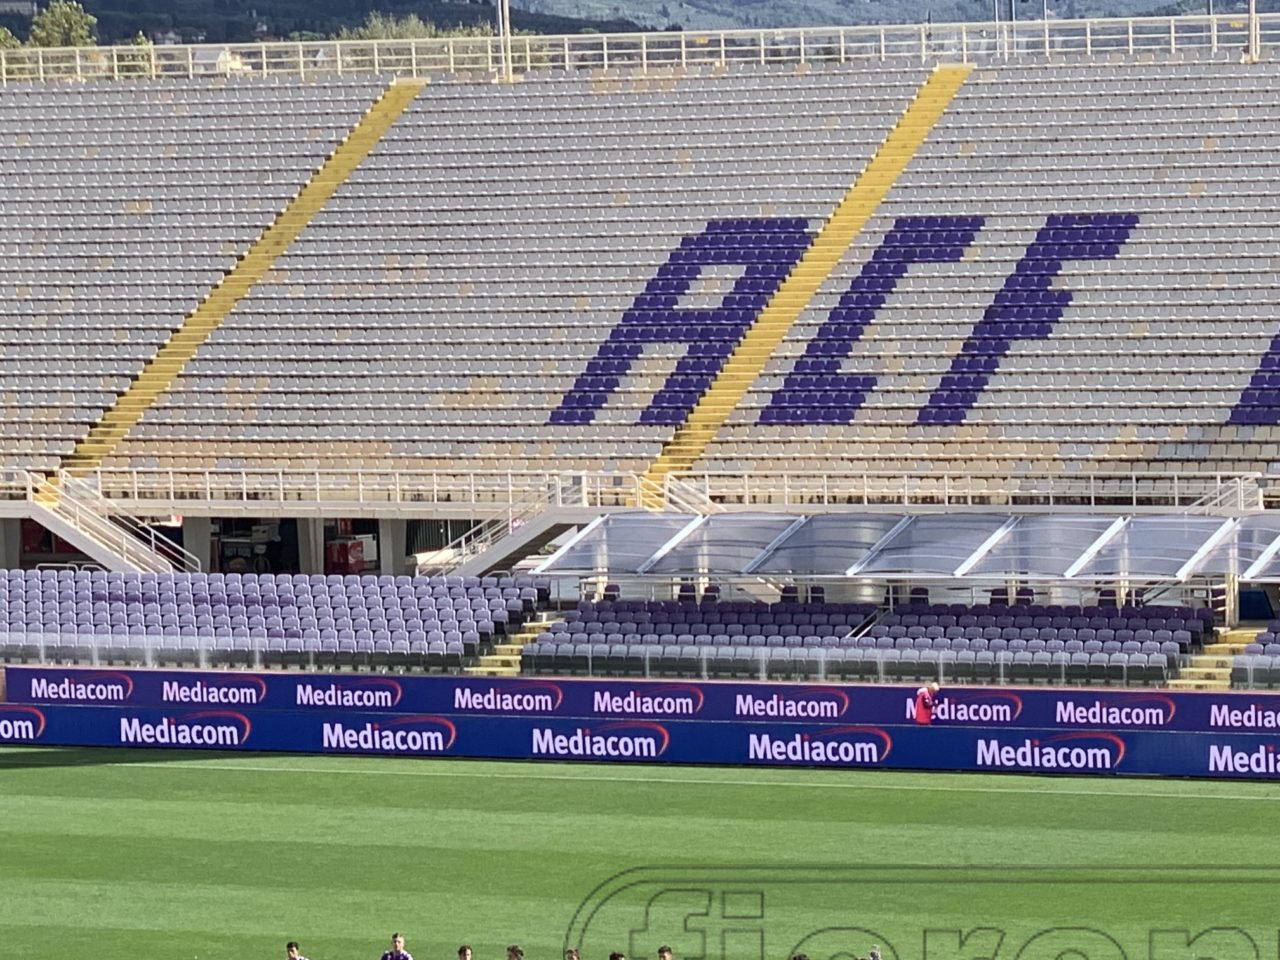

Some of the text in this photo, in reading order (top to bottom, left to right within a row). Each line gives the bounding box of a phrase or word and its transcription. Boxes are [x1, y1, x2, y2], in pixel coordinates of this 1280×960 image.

[547, 214, 1142, 426] ACF
[31, 678, 124, 700] Mediacom
[162, 681, 257, 704] Mediacom
[296, 684, 392, 707] Mediacom
[454, 687, 553, 711] Mediacom
[593, 691, 693, 714] Mediacom
[735, 694, 838, 718] Mediacom
[1056, 701, 1164, 725] Mediacom
[120, 717, 239, 745] Mediacom
[323, 723, 444, 751] Mediacom
[532, 728, 656, 757] Mediacom
[749, 733, 878, 763] Mediacom
[976, 739, 1111, 769] Mediacom
